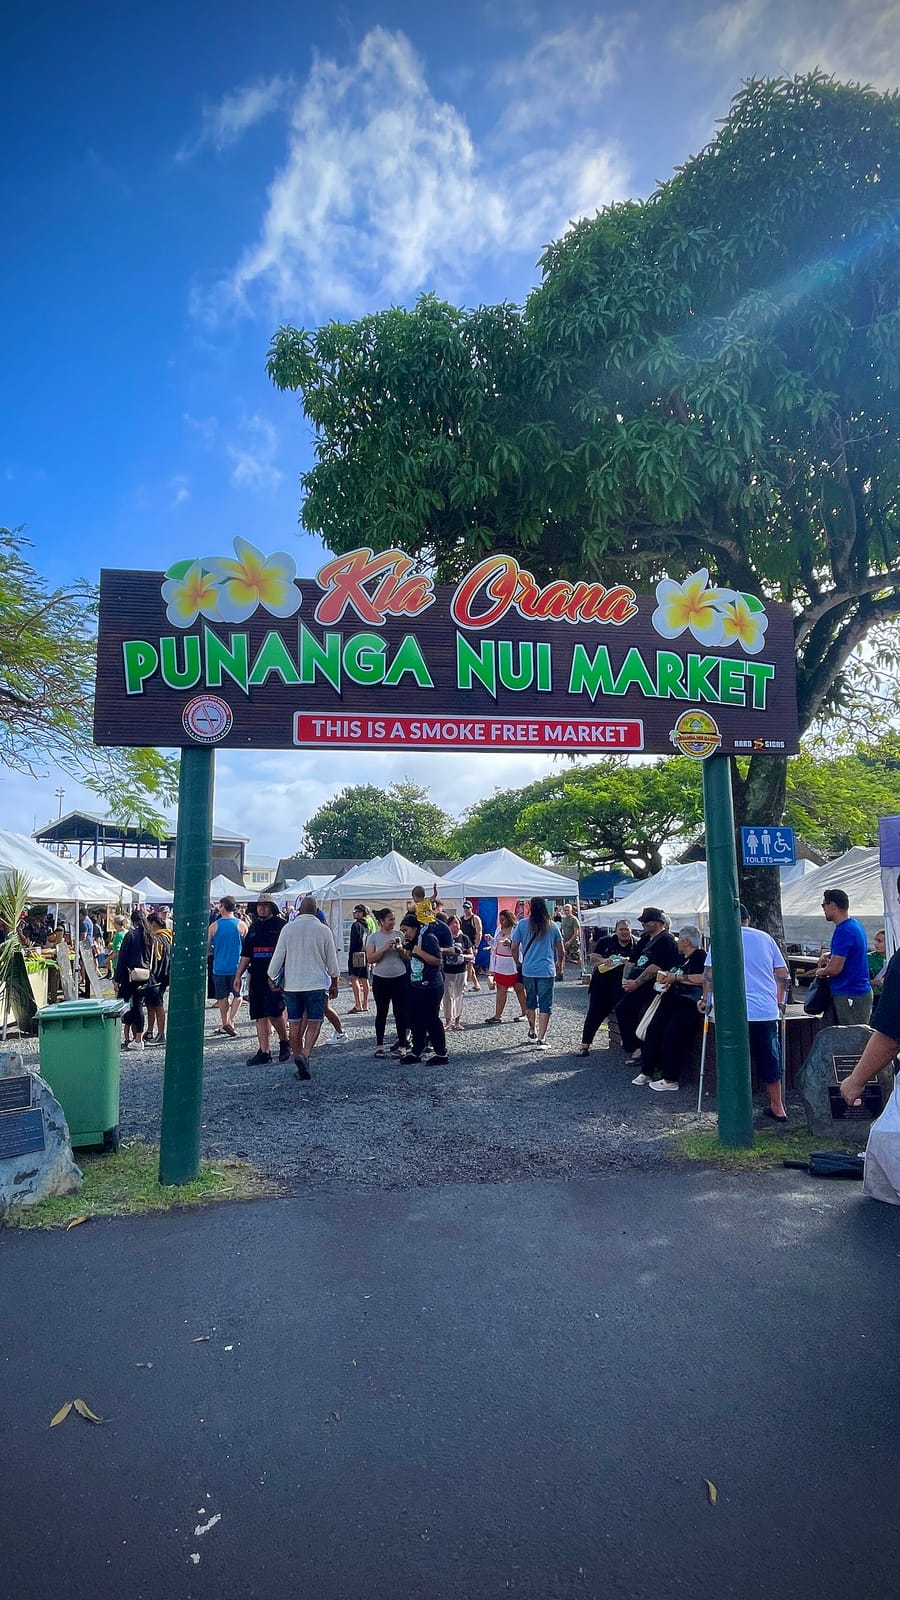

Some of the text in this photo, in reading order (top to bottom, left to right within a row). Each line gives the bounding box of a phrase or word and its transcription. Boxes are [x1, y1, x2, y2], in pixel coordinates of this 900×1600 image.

[315, 547, 639, 630] Kia Orana
[122, 621, 776, 710] PUNANGA NUI MARKET
[312, 720, 628, 743] THIS IS A SMOKE FREE MARKET
[745, 856, 774, 864] TOILETS
